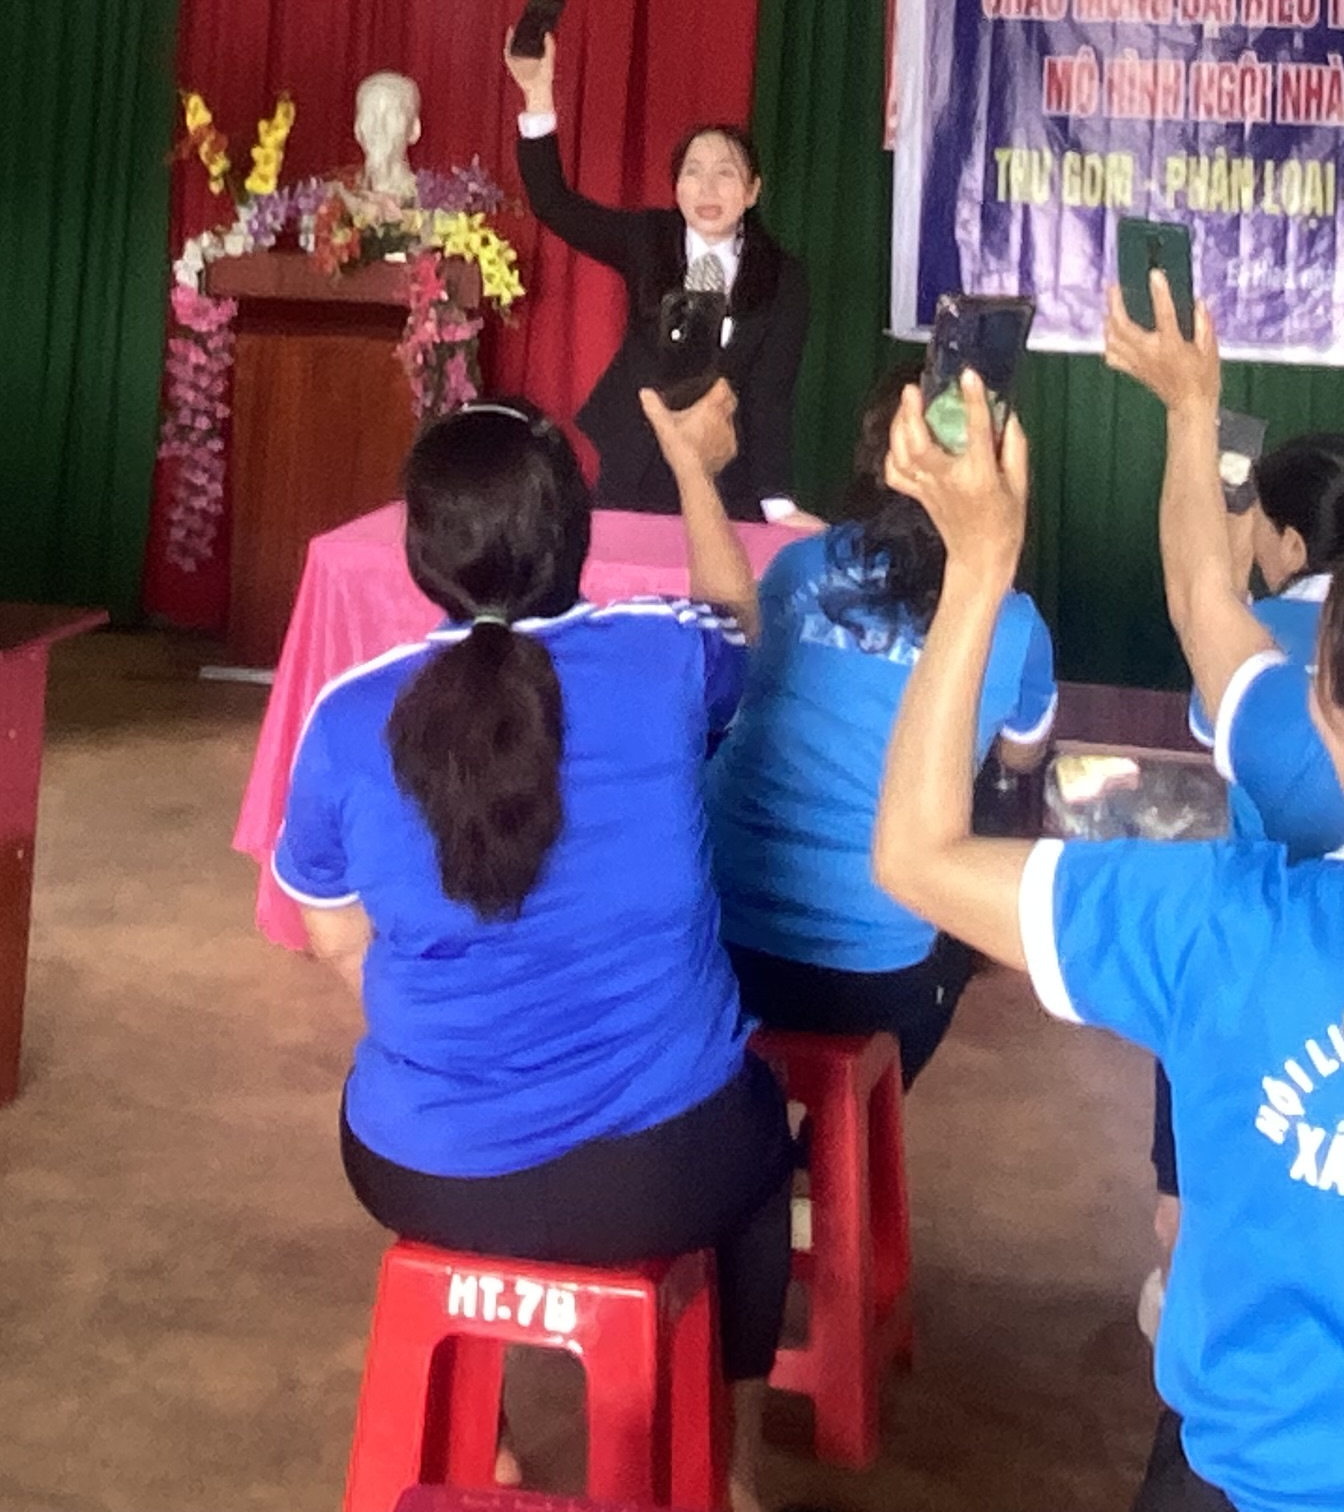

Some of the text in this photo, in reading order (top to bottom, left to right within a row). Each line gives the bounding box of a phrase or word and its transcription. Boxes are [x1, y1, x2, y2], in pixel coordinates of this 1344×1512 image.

[1043, 44, 1100, 119] MÔ
[1188, 50, 1272, 125] NGÔI
[1062, 150, 1135, 209] GOM
[1166, 146, 1255, 215] PHÂN
[1260, 159, 1335, 230] LOẠI
[1255, 1059, 1313, 1144] HỘI
